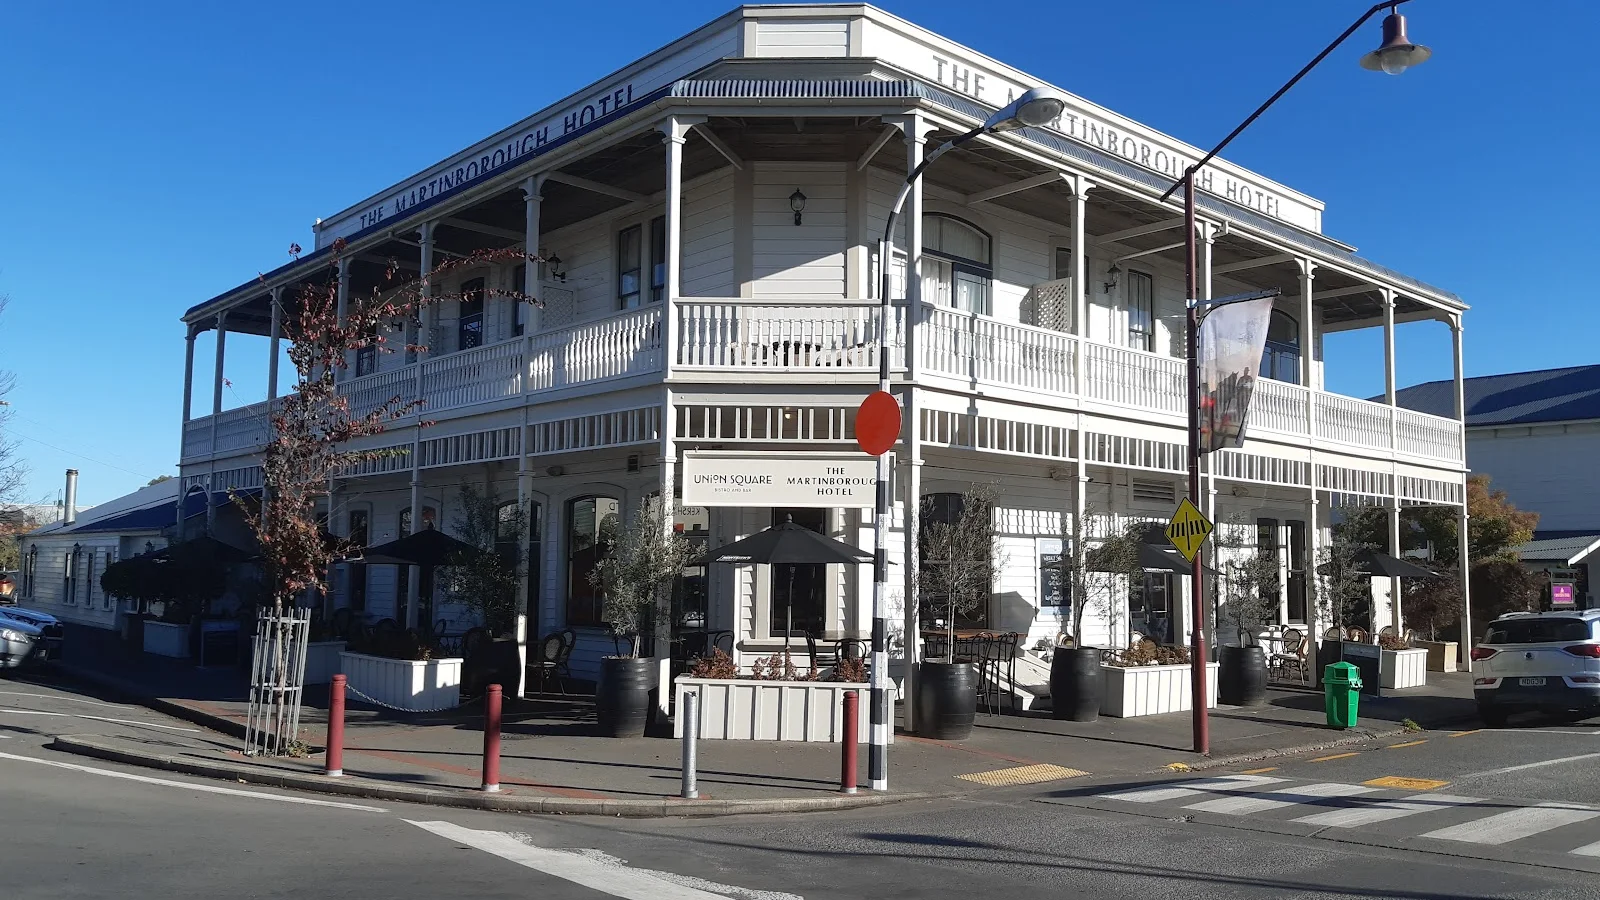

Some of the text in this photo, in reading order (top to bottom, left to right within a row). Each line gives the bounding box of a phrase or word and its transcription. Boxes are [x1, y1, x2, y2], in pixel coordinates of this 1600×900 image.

[932, 55, 985, 97] THE
[360, 84, 633, 228] THE MARTINBOROUGH HOTEL
[730, 475, 773, 485] SQUARE
[787, 477, 877, 485] MARTINBOROUG
